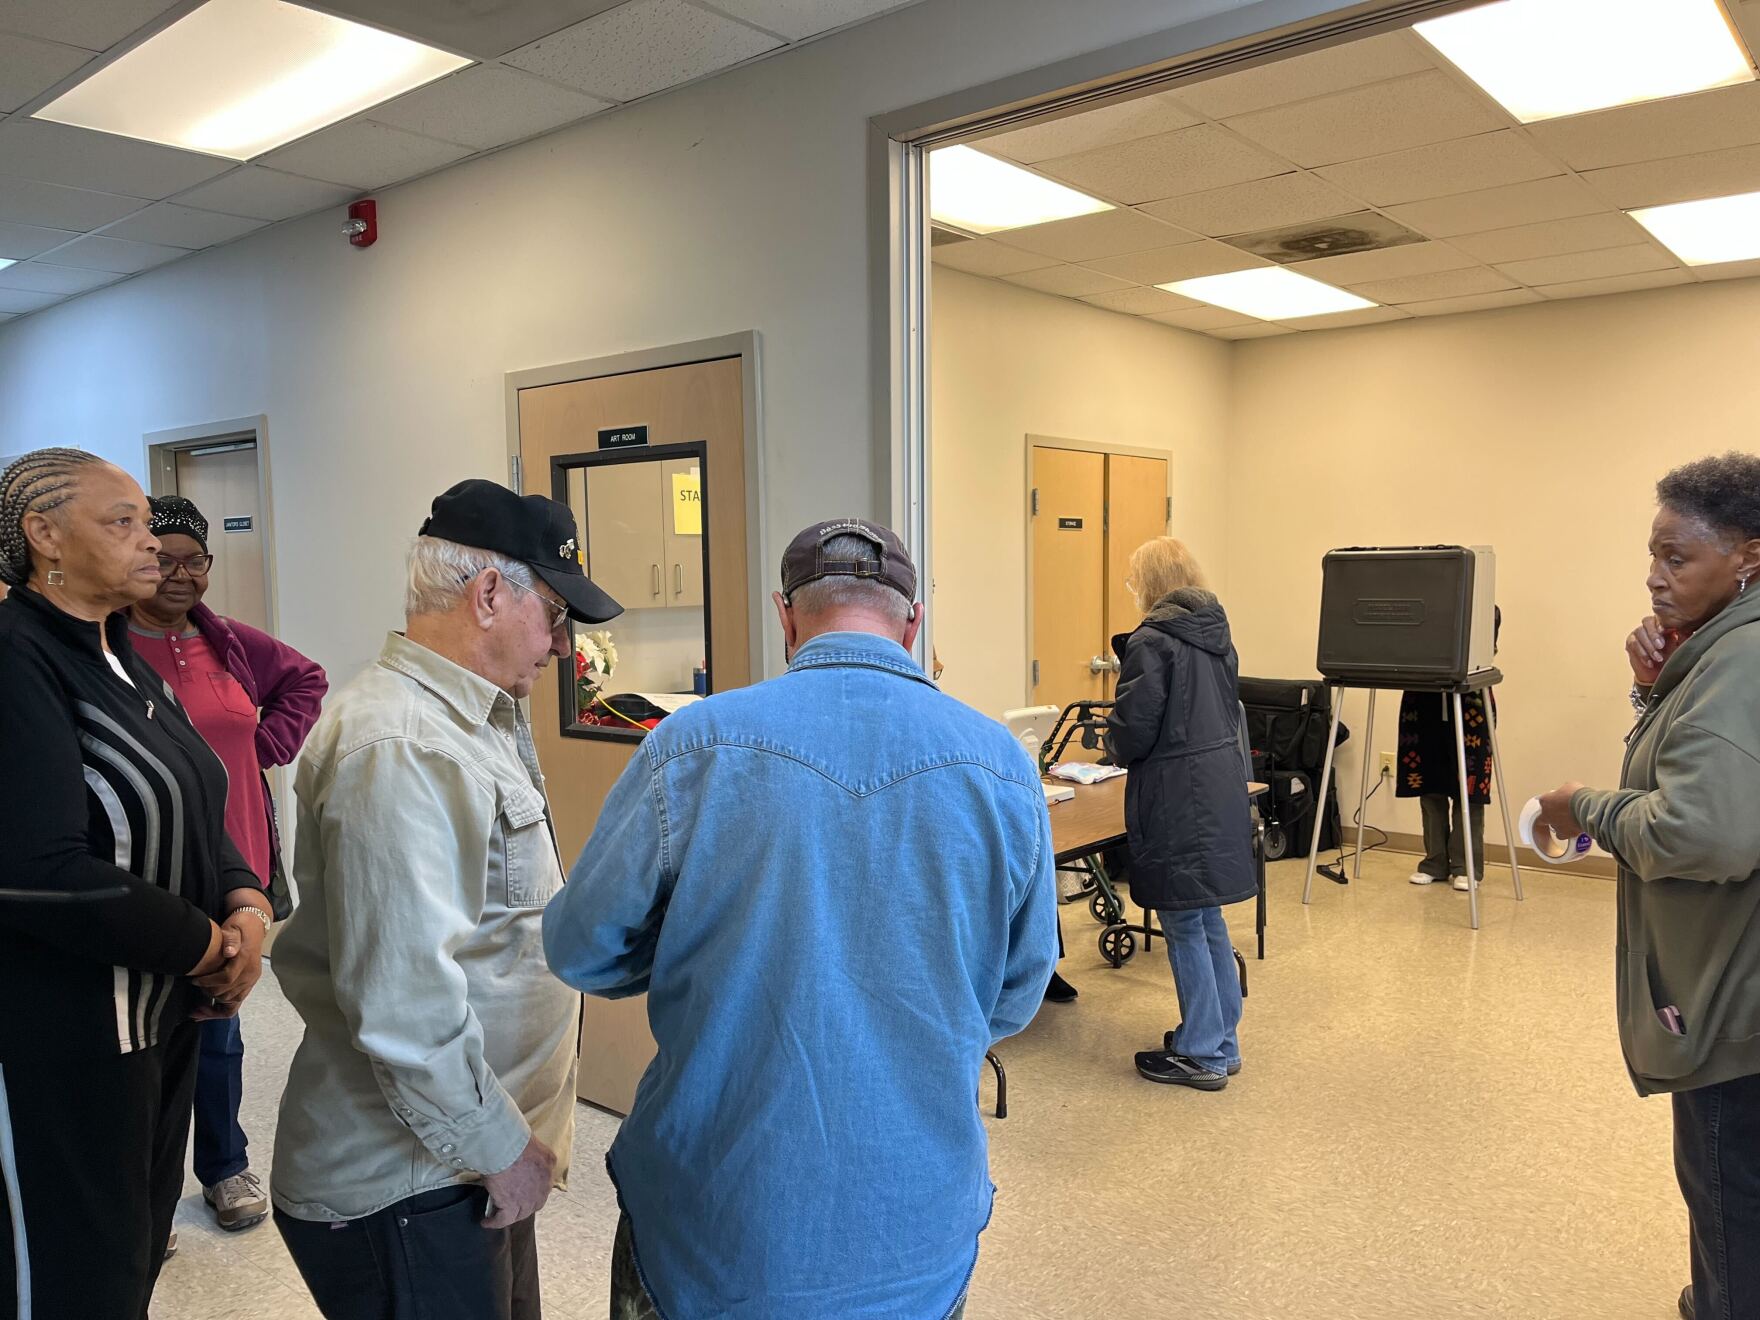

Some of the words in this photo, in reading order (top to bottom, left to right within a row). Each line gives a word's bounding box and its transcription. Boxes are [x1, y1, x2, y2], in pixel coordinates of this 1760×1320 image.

[610, 434, 620, 442] ART
[621, 433, 635, 441] ROOM
[680, 489, 701, 501] STA
